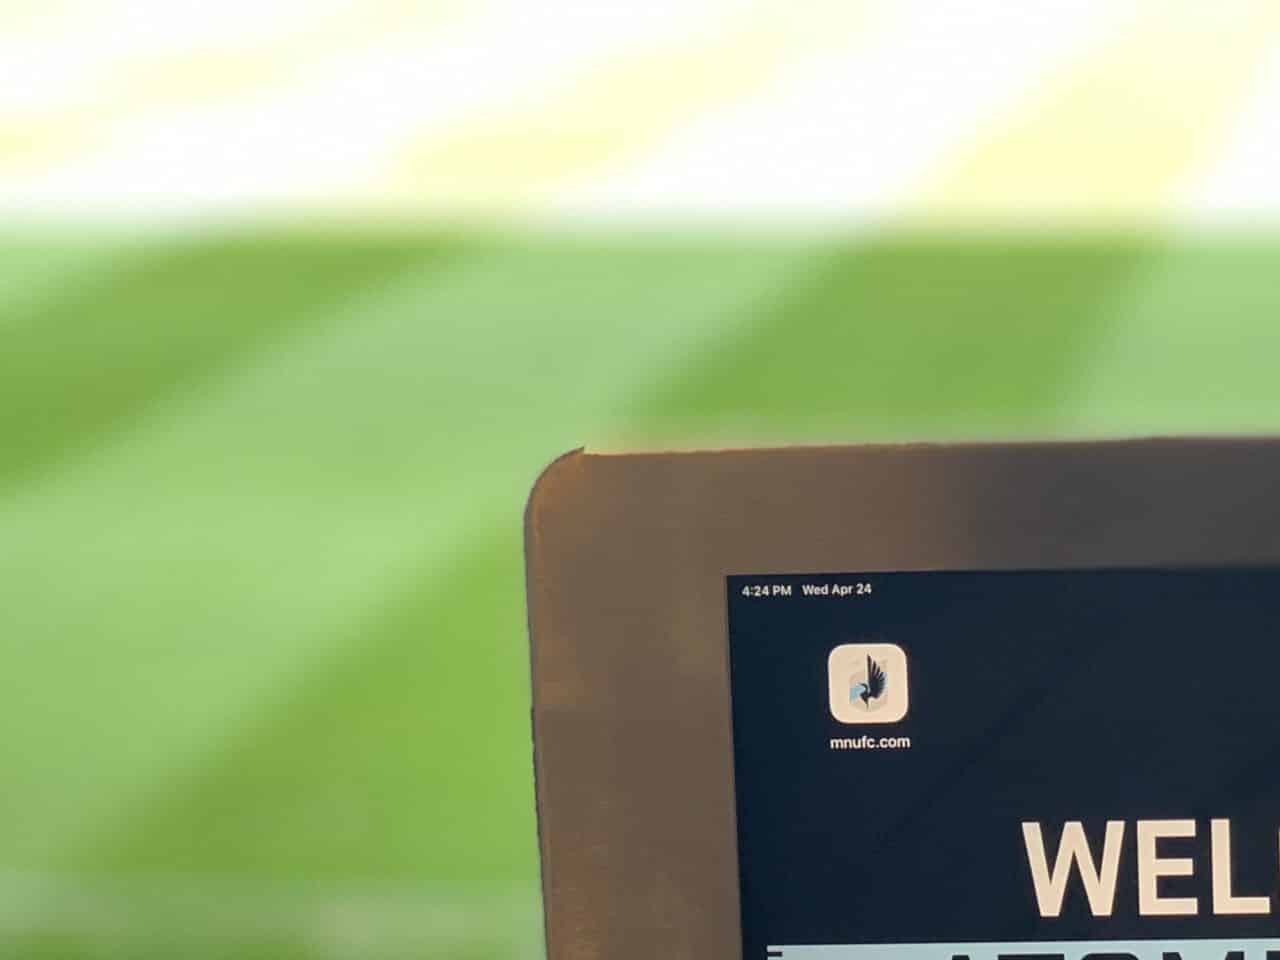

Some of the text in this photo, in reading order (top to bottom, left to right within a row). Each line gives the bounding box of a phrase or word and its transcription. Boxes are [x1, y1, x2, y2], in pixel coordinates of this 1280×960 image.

[741, 583, 872, 597] 4:24 PM Wed Apr 24
[830, 735, 911, 749] mnufc.com
